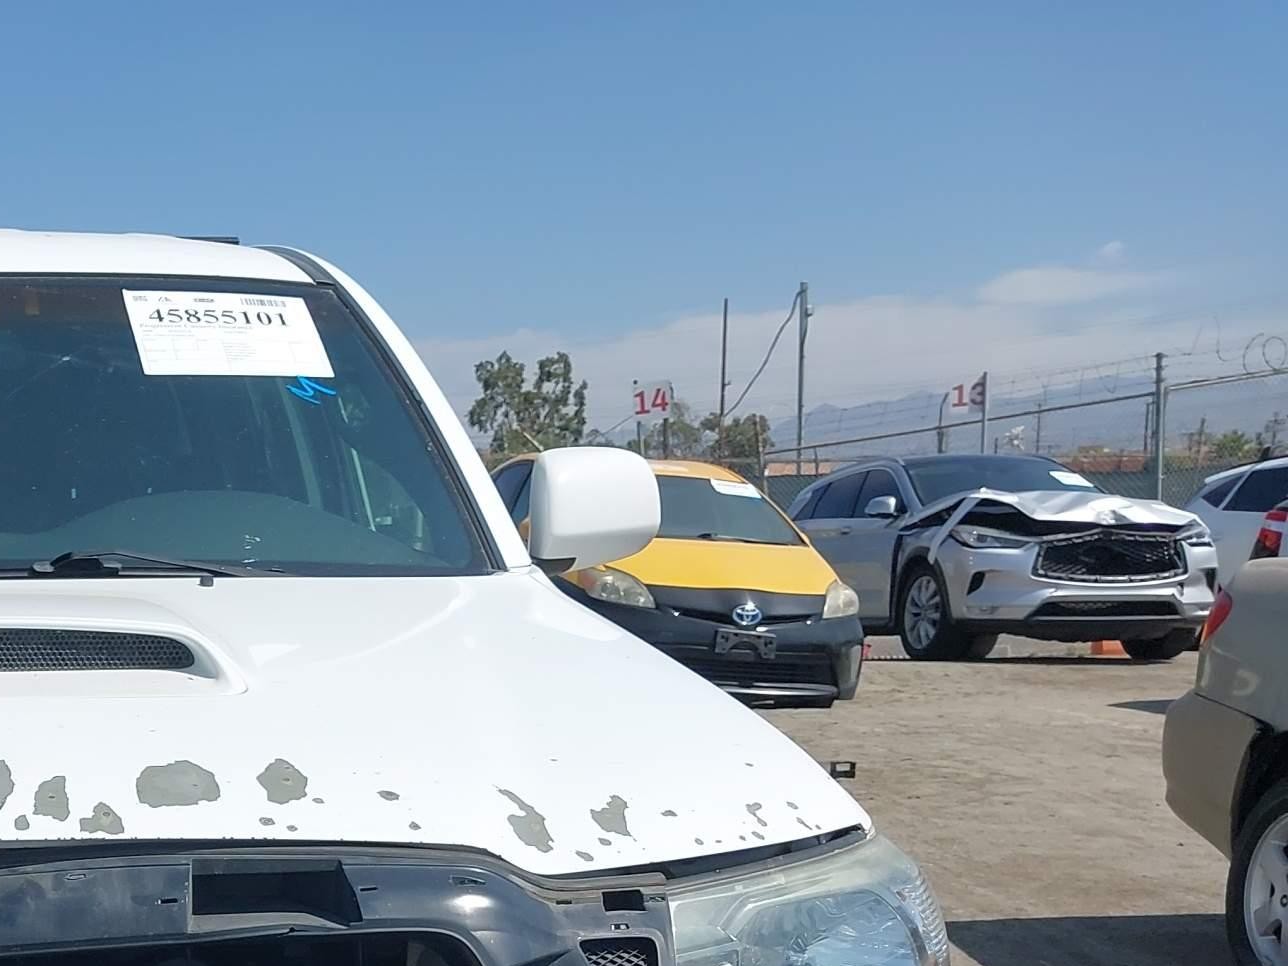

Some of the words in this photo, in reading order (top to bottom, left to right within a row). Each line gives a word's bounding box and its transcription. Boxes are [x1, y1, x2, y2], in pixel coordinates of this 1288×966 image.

[149, 308, 288, 327] 45855101
[633, 388, 669, 415] 14
[951, 382, 985, 407] 13
